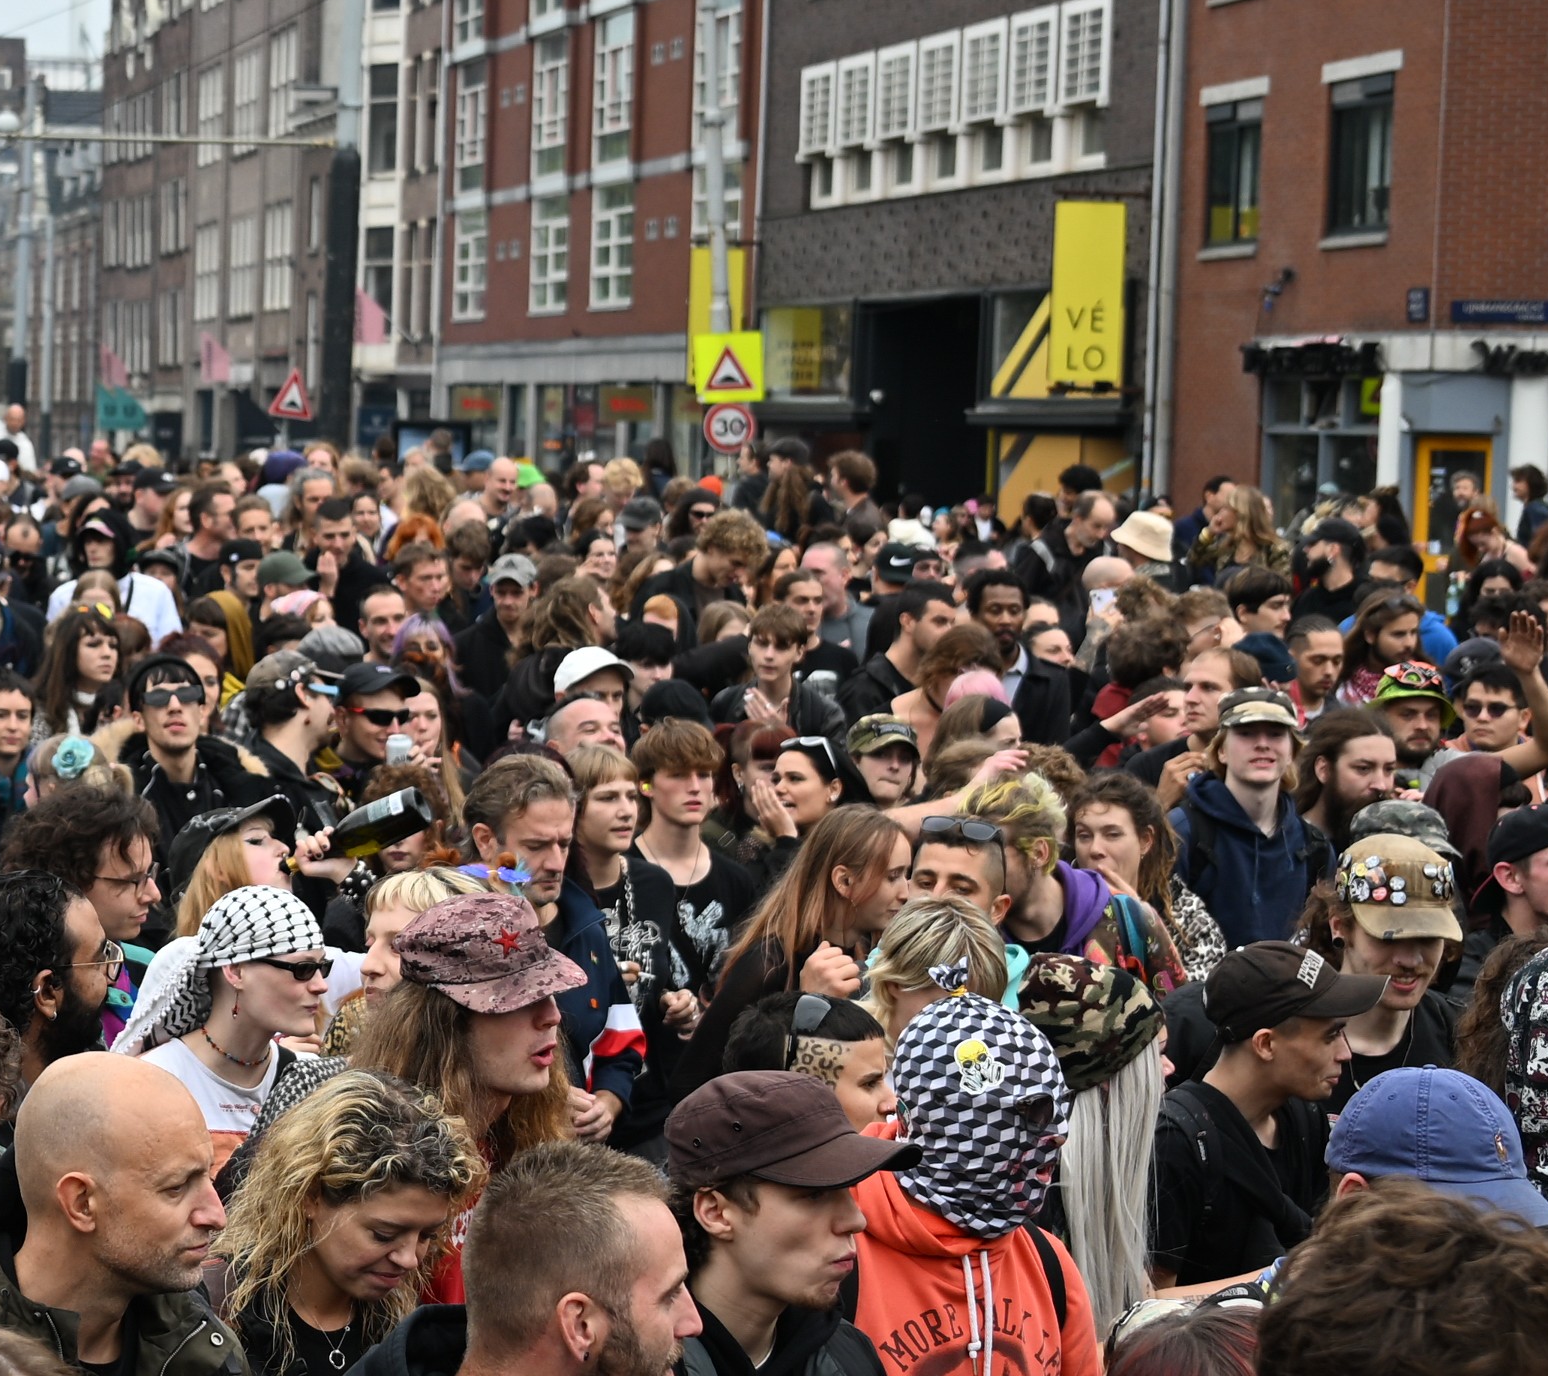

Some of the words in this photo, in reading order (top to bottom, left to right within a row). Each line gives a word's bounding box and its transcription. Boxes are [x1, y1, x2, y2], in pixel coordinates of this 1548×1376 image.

[1066, 299, 1103, 333] VÉ
[1067, 345, 1104, 372] LO
[715, 417, 746, 437] 30
[879, 1303, 964, 1373] MORE
